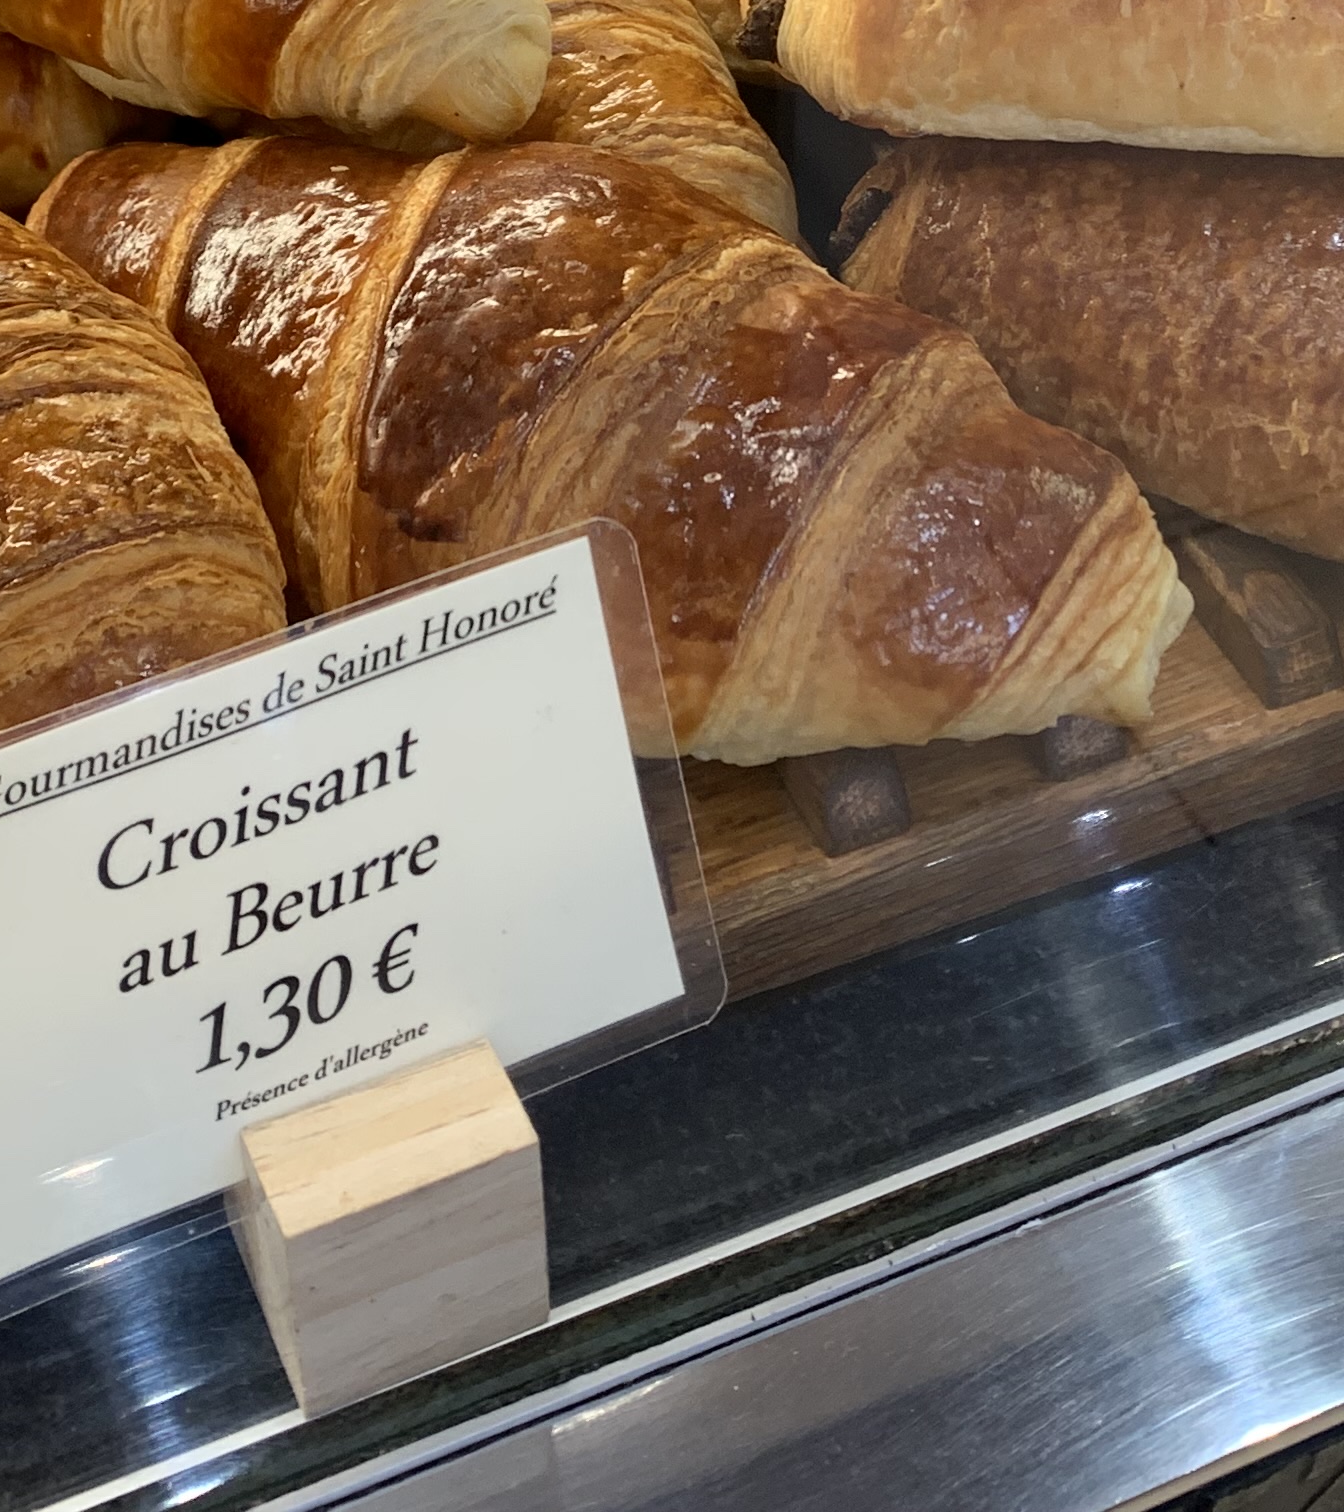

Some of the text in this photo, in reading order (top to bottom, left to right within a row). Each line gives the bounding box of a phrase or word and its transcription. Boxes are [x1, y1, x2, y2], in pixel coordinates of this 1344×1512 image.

[259, 670, 305, 715] de
[313, 634, 408, 696] Saint
[417, 574, 559, 656] Honoré
[96, 728, 420, 892] Croissant
[119, 833, 440, 993] au Beurre
[213, 1021, 429, 1122] Présence d'allergène
